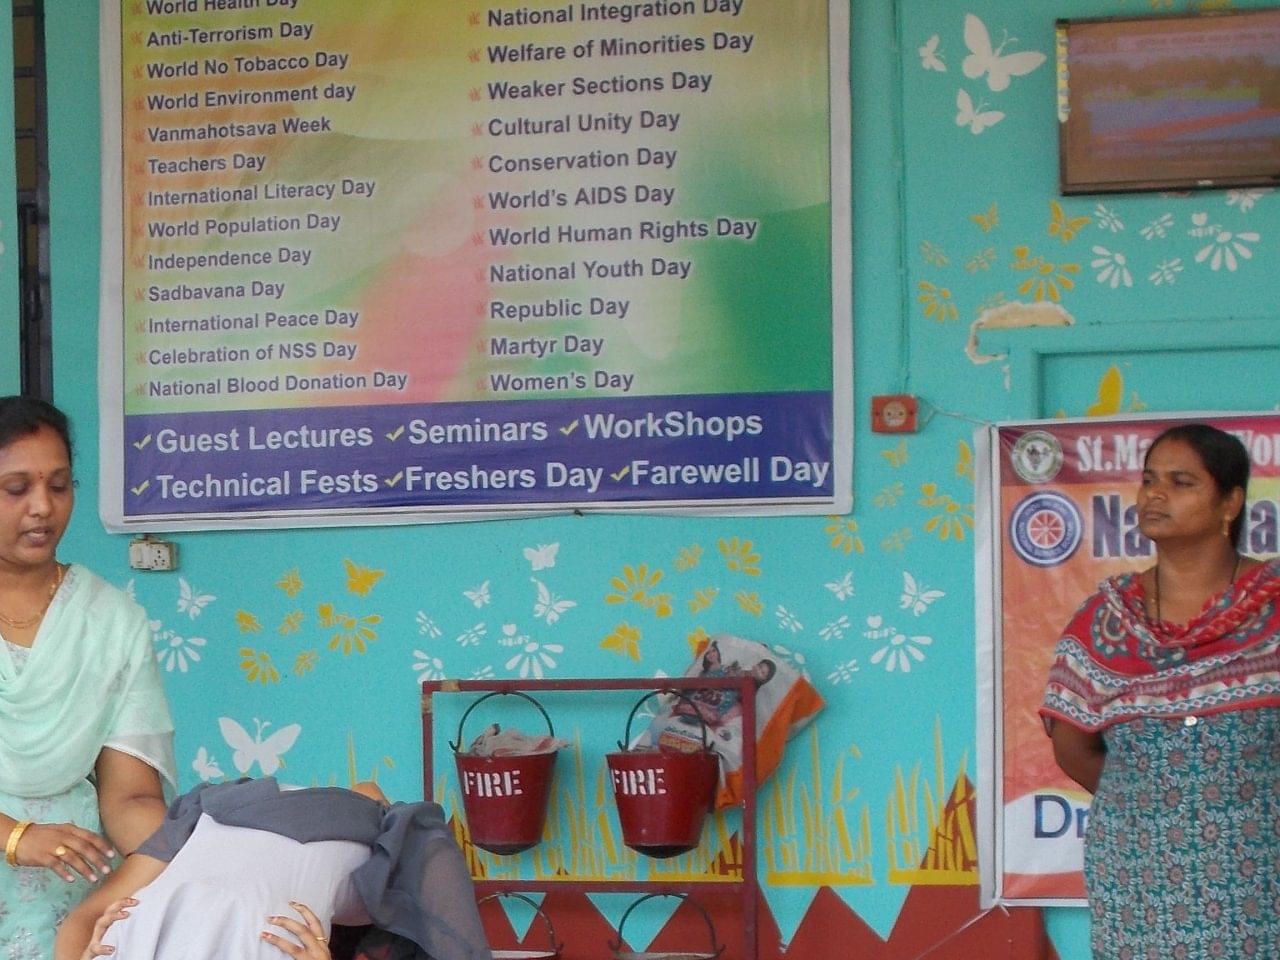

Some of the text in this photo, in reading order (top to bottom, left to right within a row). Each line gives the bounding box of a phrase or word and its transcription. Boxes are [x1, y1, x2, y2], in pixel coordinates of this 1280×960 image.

[147, 0, 198, 15] World
[204, 0, 260, 11] Health
[488, 0, 743, 26] National Integration Day
[147, 22, 313, 46] Anti-Terrorism Day
[488, 32, 754, 63] Welfare of Minorities Day
[148, 52, 348, 79] World No Tobacco Day
[148, 84, 355, 110] World Environment day
[488, 72, 712, 99] Weaker Sections Day
[149, 117, 331, 142] Vanmahotsava Week
[489, 111, 680, 136] Cultural Unity Day
[149, 153, 265, 174] Teachers Day
[489, 148, 677, 173] Conservation Day
[149, 180, 375, 206] International Literacy Day
[489, 185, 675, 209] World's AIDS Day
[149, 213, 340, 237] World Population Day
[490, 219, 756, 245] World Human Rights Day
[149, 248, 311, 270] Independence Day
[491, 258, 691, 282] National Youth Day
[149, 281, 284, 301] Sadbavana Day
[149, 310, 359, 333] International Peace Day
[491, 298, 629, 321] Republic Day
[149, 342, 356, 365] Celebration of NSS Day
[491, 335, 604, 358] Martyr Day
[149, 372, 407, 396] National Blood Donation Day
[491, 371, 633, 391] Women's Day
[157, 411, 762, 453] Guest Lectures Seminars WorkShops
[157, 456, 829, 499] Technical Fests Freshers Day Farewell Day
[464, 770, 522, 797] FIRE
[612, 768, 666, 795] FIRE
